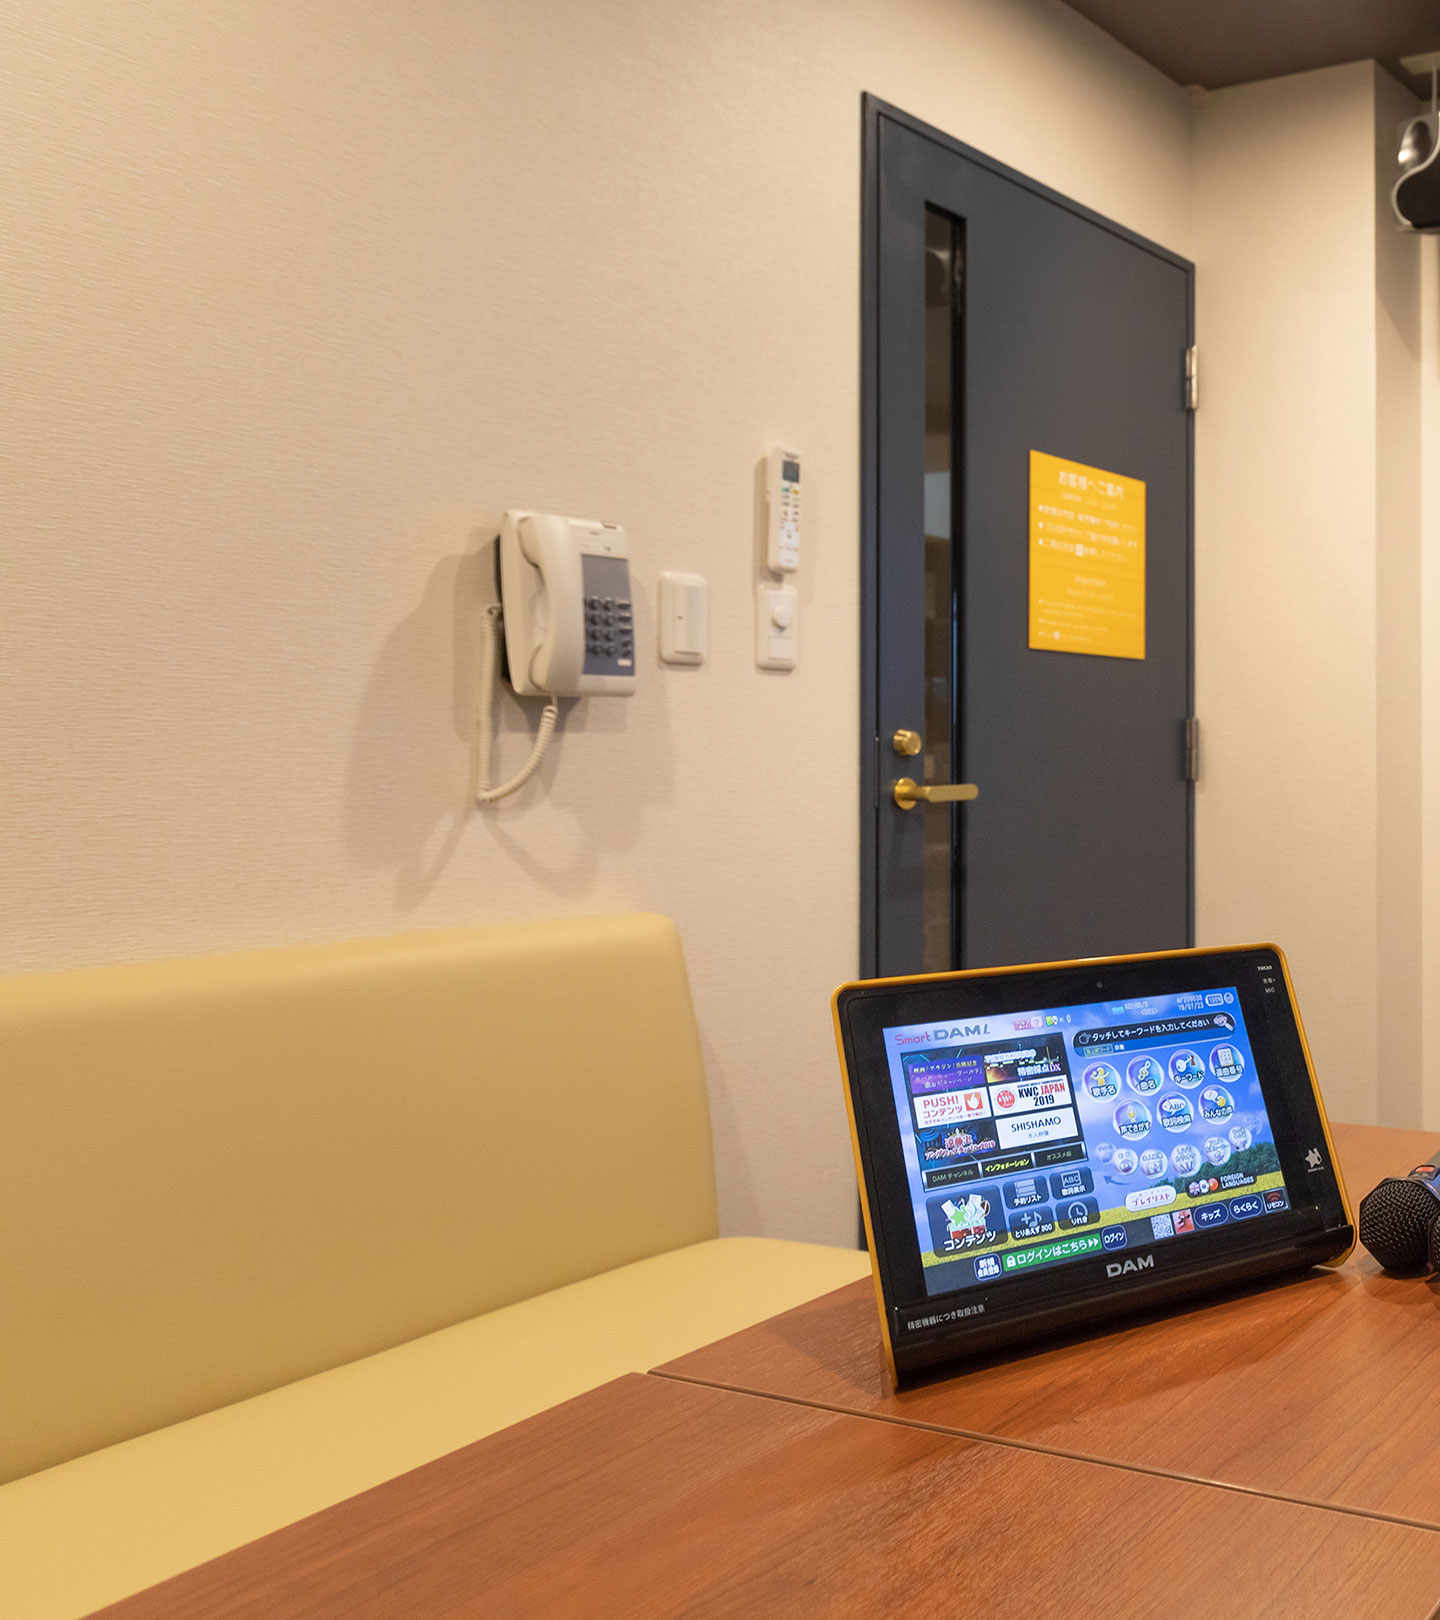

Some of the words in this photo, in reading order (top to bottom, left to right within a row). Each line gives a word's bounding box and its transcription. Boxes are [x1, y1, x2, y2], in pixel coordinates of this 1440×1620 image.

[1091, 1019, 1210, 1042] タッチしてキーワードを入力してください
[895, 1031, 931, 1046] Smart
[1174, 1071, 1204, 1084] キーワード
[1018, 1086, 1040, 1099] KWC
[1040, 1082, 1066, 1096] JAPAN
[1092, 1084, 1117, 1097] 歌手名
[1139, 1079, 1157, 1091] 曲名
[923, 1095, 960, 1109] PUSH!
[1034, 1094, 1055, 1107] 2019
[922, 1104, 964, 1119] コンテンツ
[1011, 1116, 1062, 1133] SHISHAMO
[1119, 1121, 1151, 1136] 声でさがす
[984, 1158, 1030, 1173] インフォメーション
[1220, 1172, 1244, 1184] FOREIGN
[1221, 1177, 1254, 1189] LANGUAGES
[1233, 1200, 1260, 1215] らくらく
[1266, 1200, 1285, 1210] リモコン
[1071, 1216, 1088, 1226] りれき
[1201, 1209, 1222, 1222] キッズ
[943, 1230, 997, 1252] コンテンツ
[1104, 1232, 1125, 1244] ログイン
[1017, 1240, 1087, 1265] ログインはこちら
[1106, 1254, 1155, 1278] DAM
